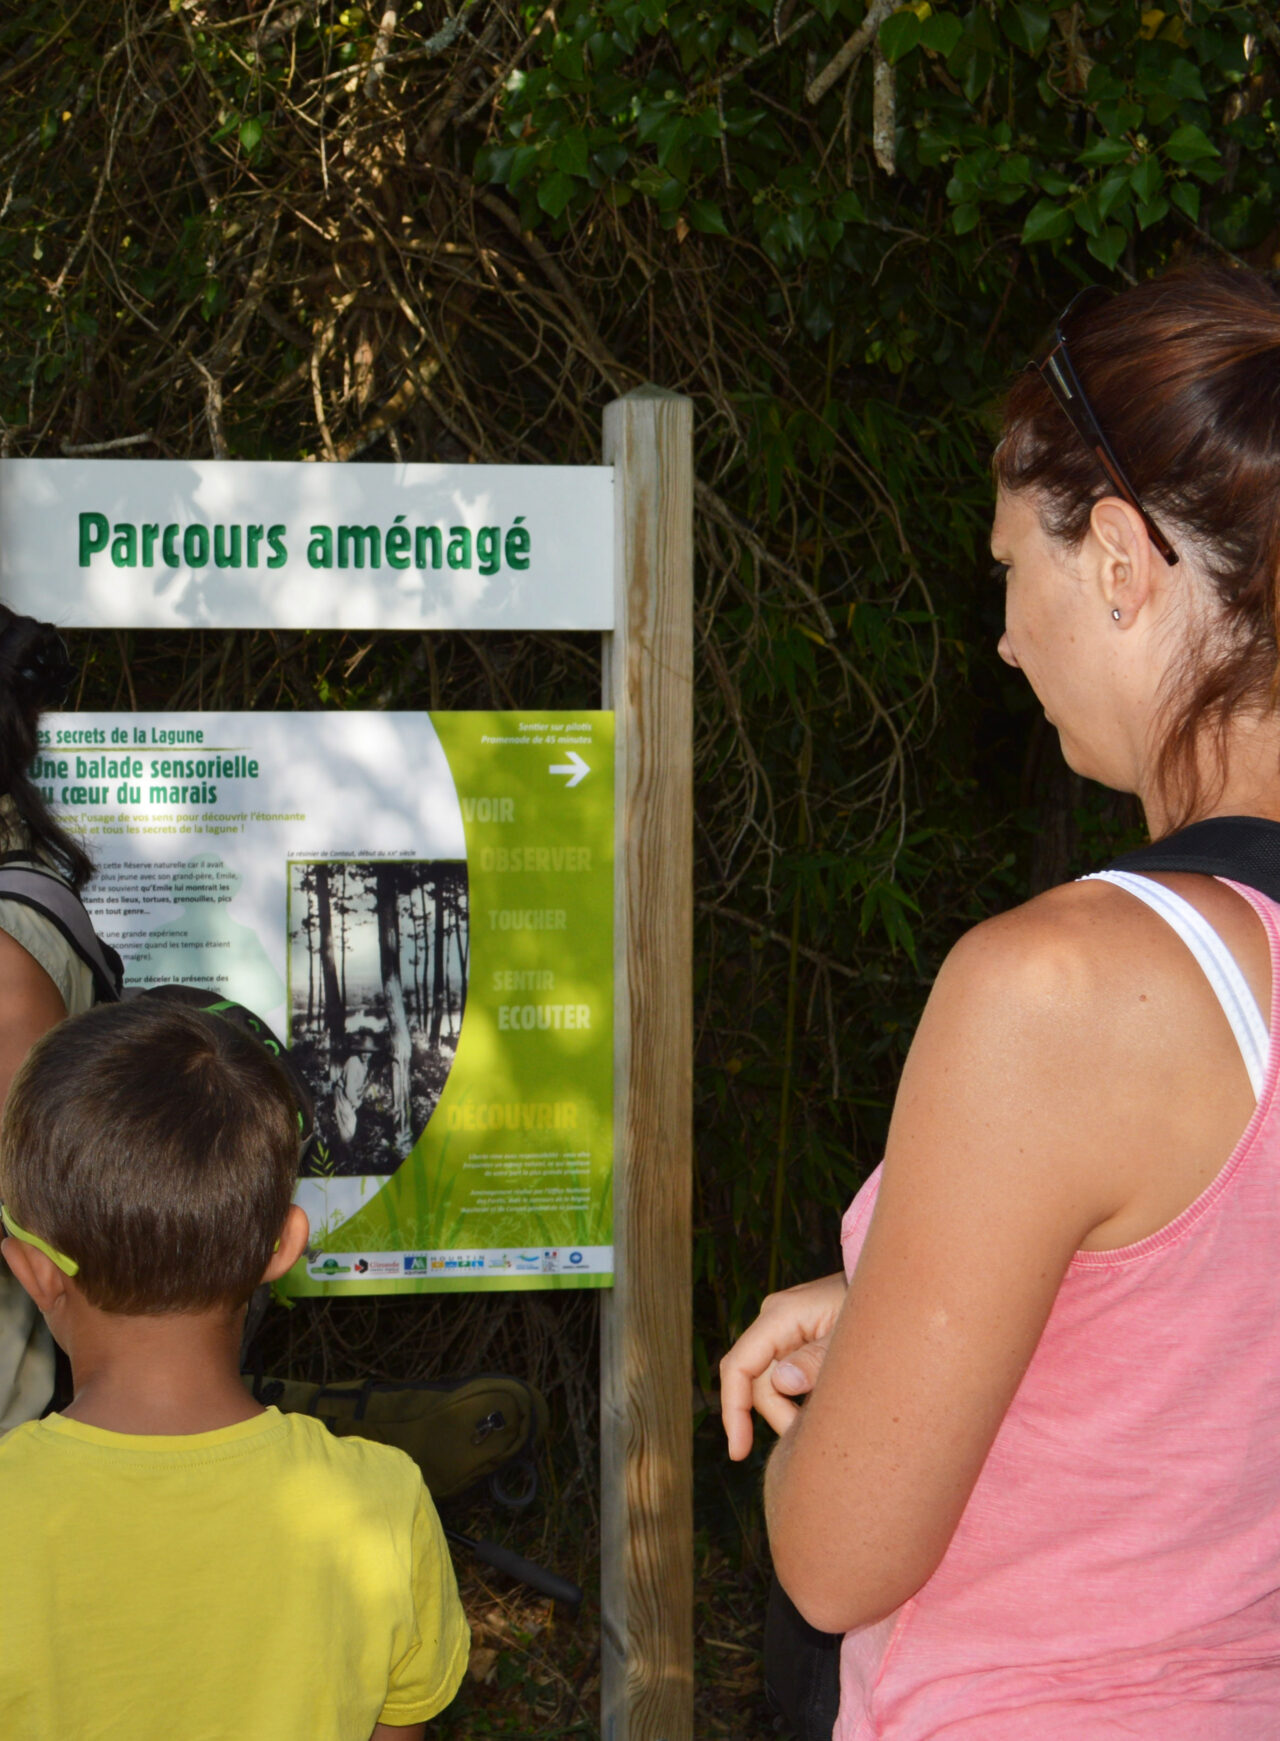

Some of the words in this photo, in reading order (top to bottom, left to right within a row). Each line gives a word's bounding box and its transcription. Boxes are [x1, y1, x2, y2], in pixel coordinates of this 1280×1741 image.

[78, 511, 288, 569] Parcours
[307, 515, 531, 576] aménagé
[38, 730, 51, 744] es
[56, 728, 105, 744] secrets
[111, 728, 128, 744] de
[133, 727, 146, 744] la
[152, 727, 204, 745] Lagune
[519, 722, 549, 731] Sentier
[565, 722, 592, 732] pilotis
[481, 735, 530, 744] Promenade
[532, 736, 543, 744] de
[545, 736, 555, 744] 45
[557, 736, 592, 744] minutes
[29, 756, 68, 779] Une
[76, 756, 143, 778] balade
[150, 756, 259, 778] sensorielle
[62, 786, 109, 804] cœur
[117, 782, 140, 804] du
[149, 782, 218, 804] marais
[81, 813, 114, 824] l'usage
[118, 813, 130, 822] de
[176, 815, 198, 824] pour
[202, 812, 248, 822] découvrir
[250, 812, 306, 822] l'étonnante
[461, 797, 514, 822] VOIR
[126, 825, 140, 833] les
[179, 825, 192, 833] de
[195, 825, 204, 833] la
[206, 824, 238, 836] lagune
[480, 846, 592, 872] OBSERVER
[488, 909, 567, 930] TOUCHER
[493, 970, 554, 991] SENTIR
[498, 1004, 592, 1030] ECOUTER
[447, 1099, 578, 1130] DÉCOUVRIR
